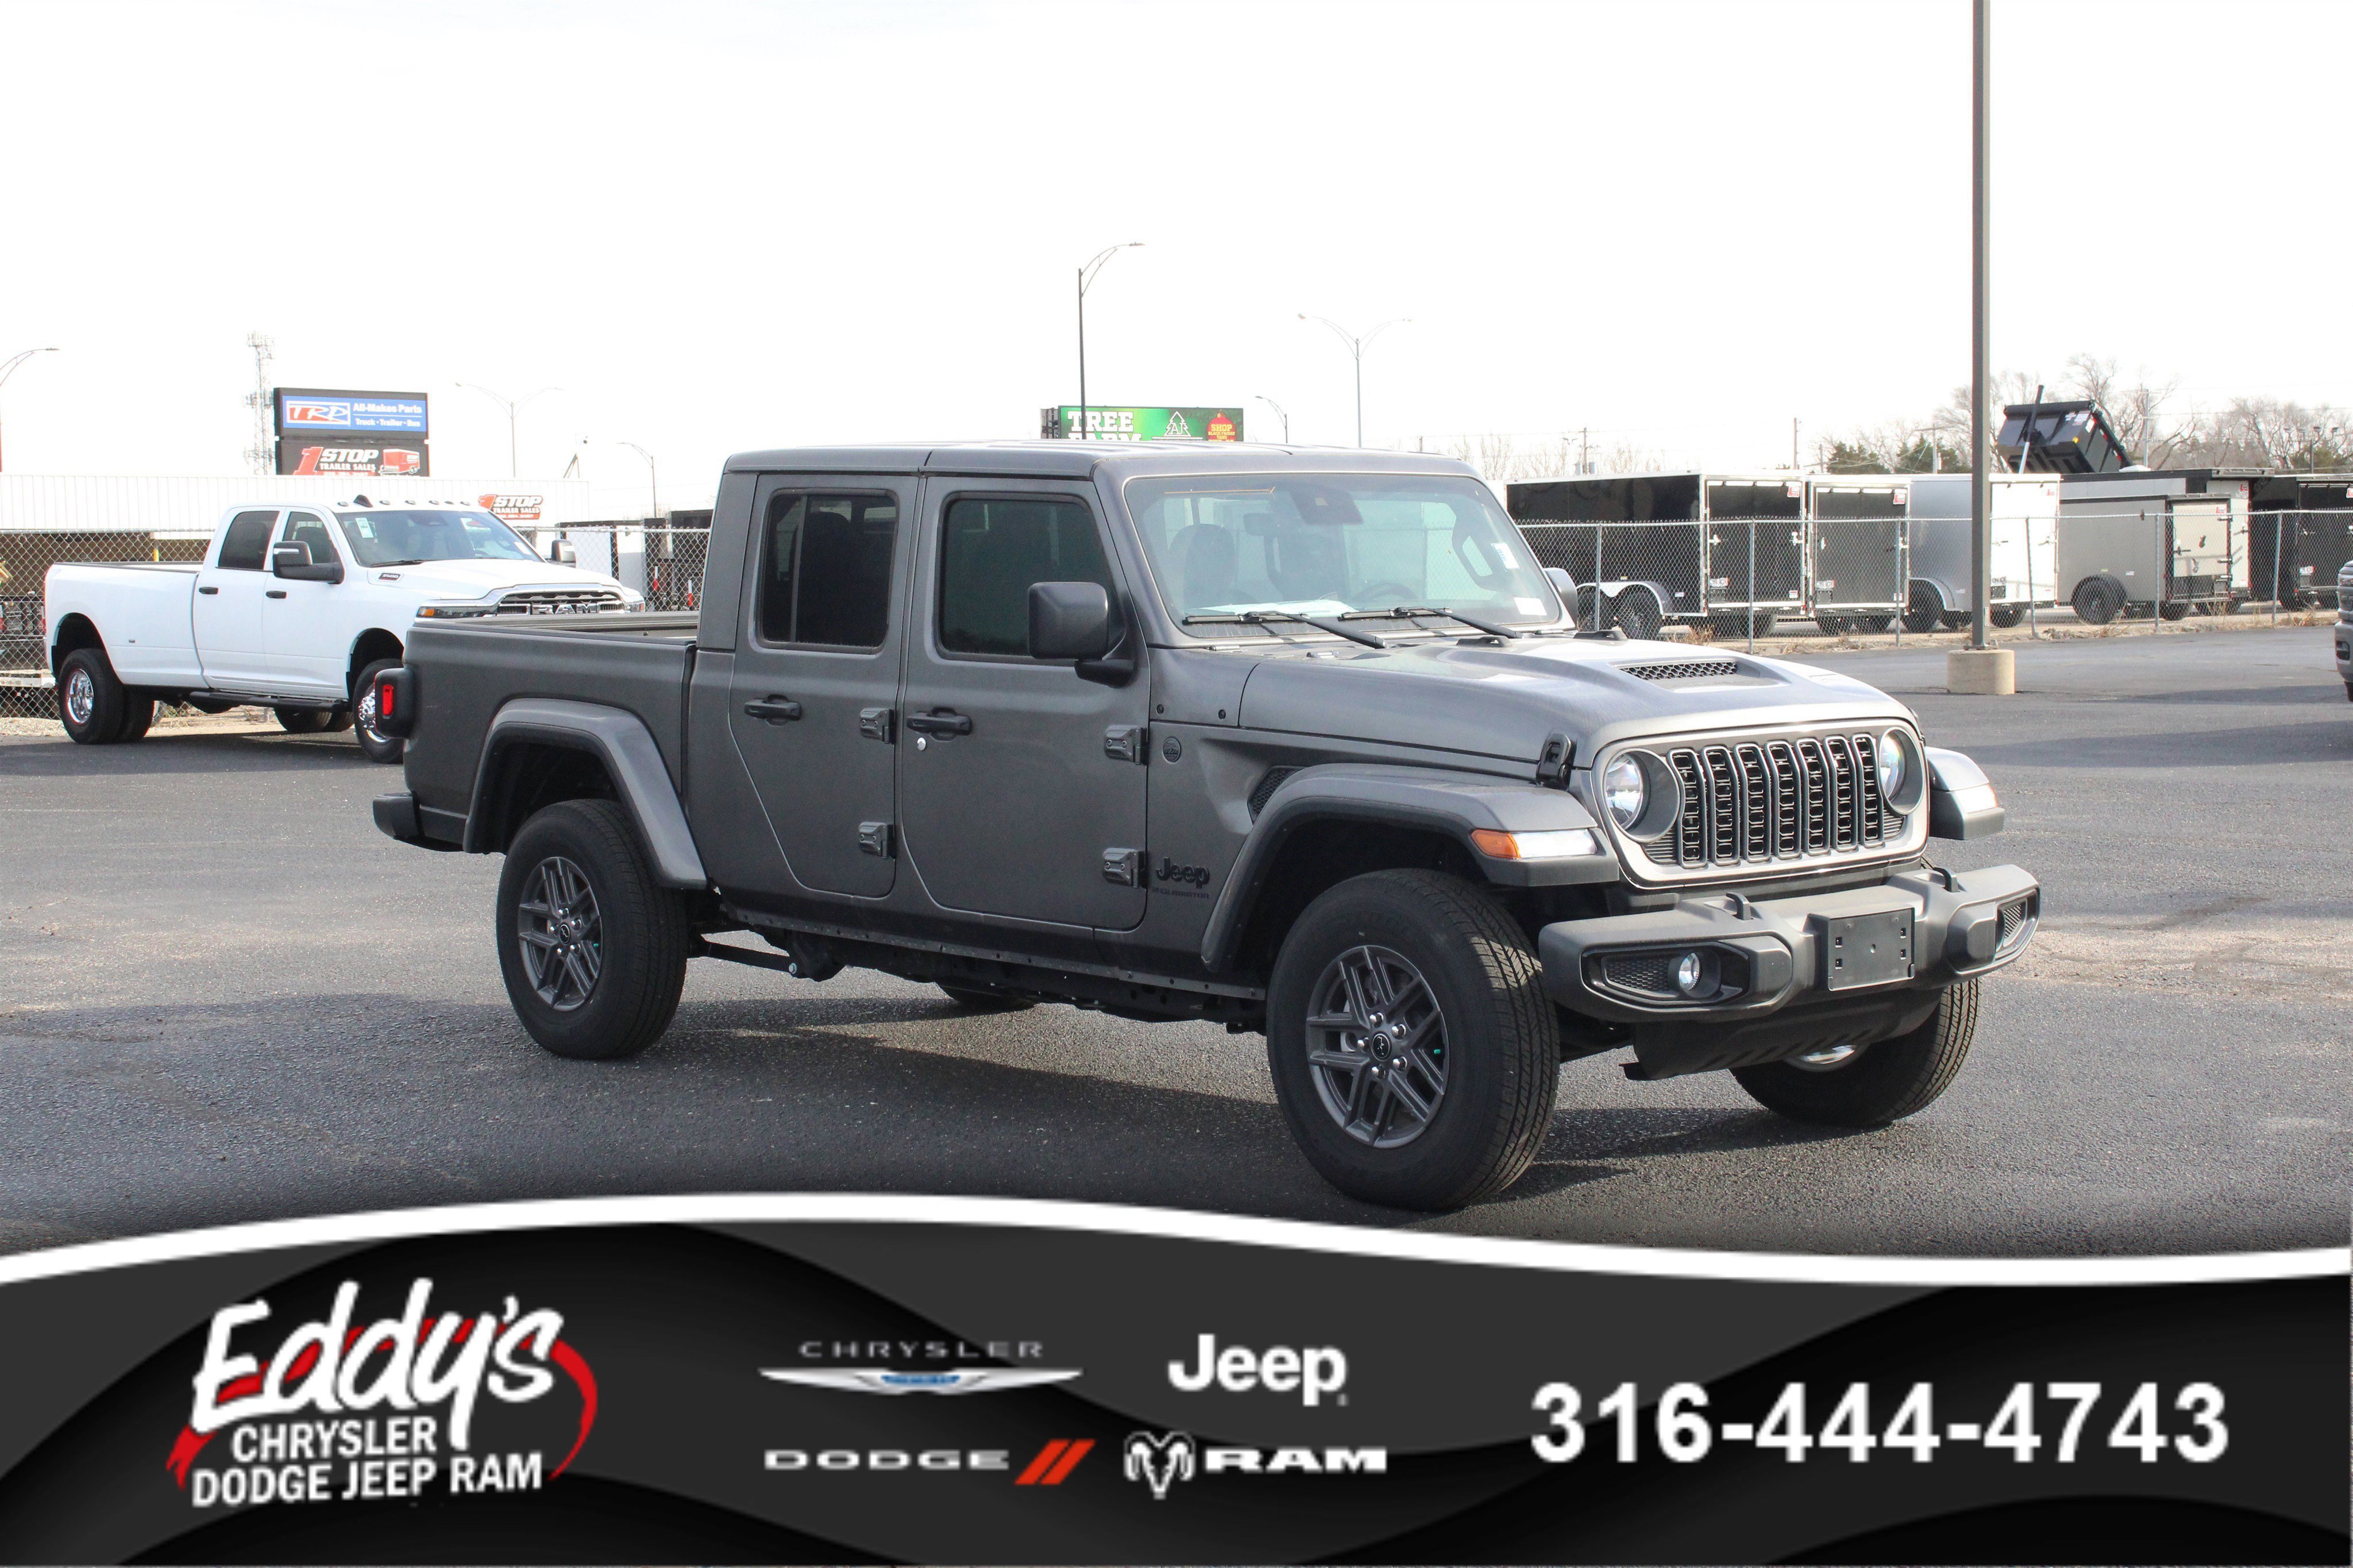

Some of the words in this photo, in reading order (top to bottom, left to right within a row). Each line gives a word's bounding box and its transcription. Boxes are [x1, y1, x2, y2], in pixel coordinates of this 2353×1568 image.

[288, 405, 349, 423] TRP
[353, 403, 398, 413] All-Makes
[398, 404, 422, 413] Parts
[1067, 411, 1133, 432] TREE
[293, 447, 323, 476] 1
[320, 449, 379, 462] STOP
[478, 495, 497, 511] 1
[493, 496, 542, 507] STOP
[531, 604, 597, 615] RAM
[1156, 857, 1210, 889] Jeep
